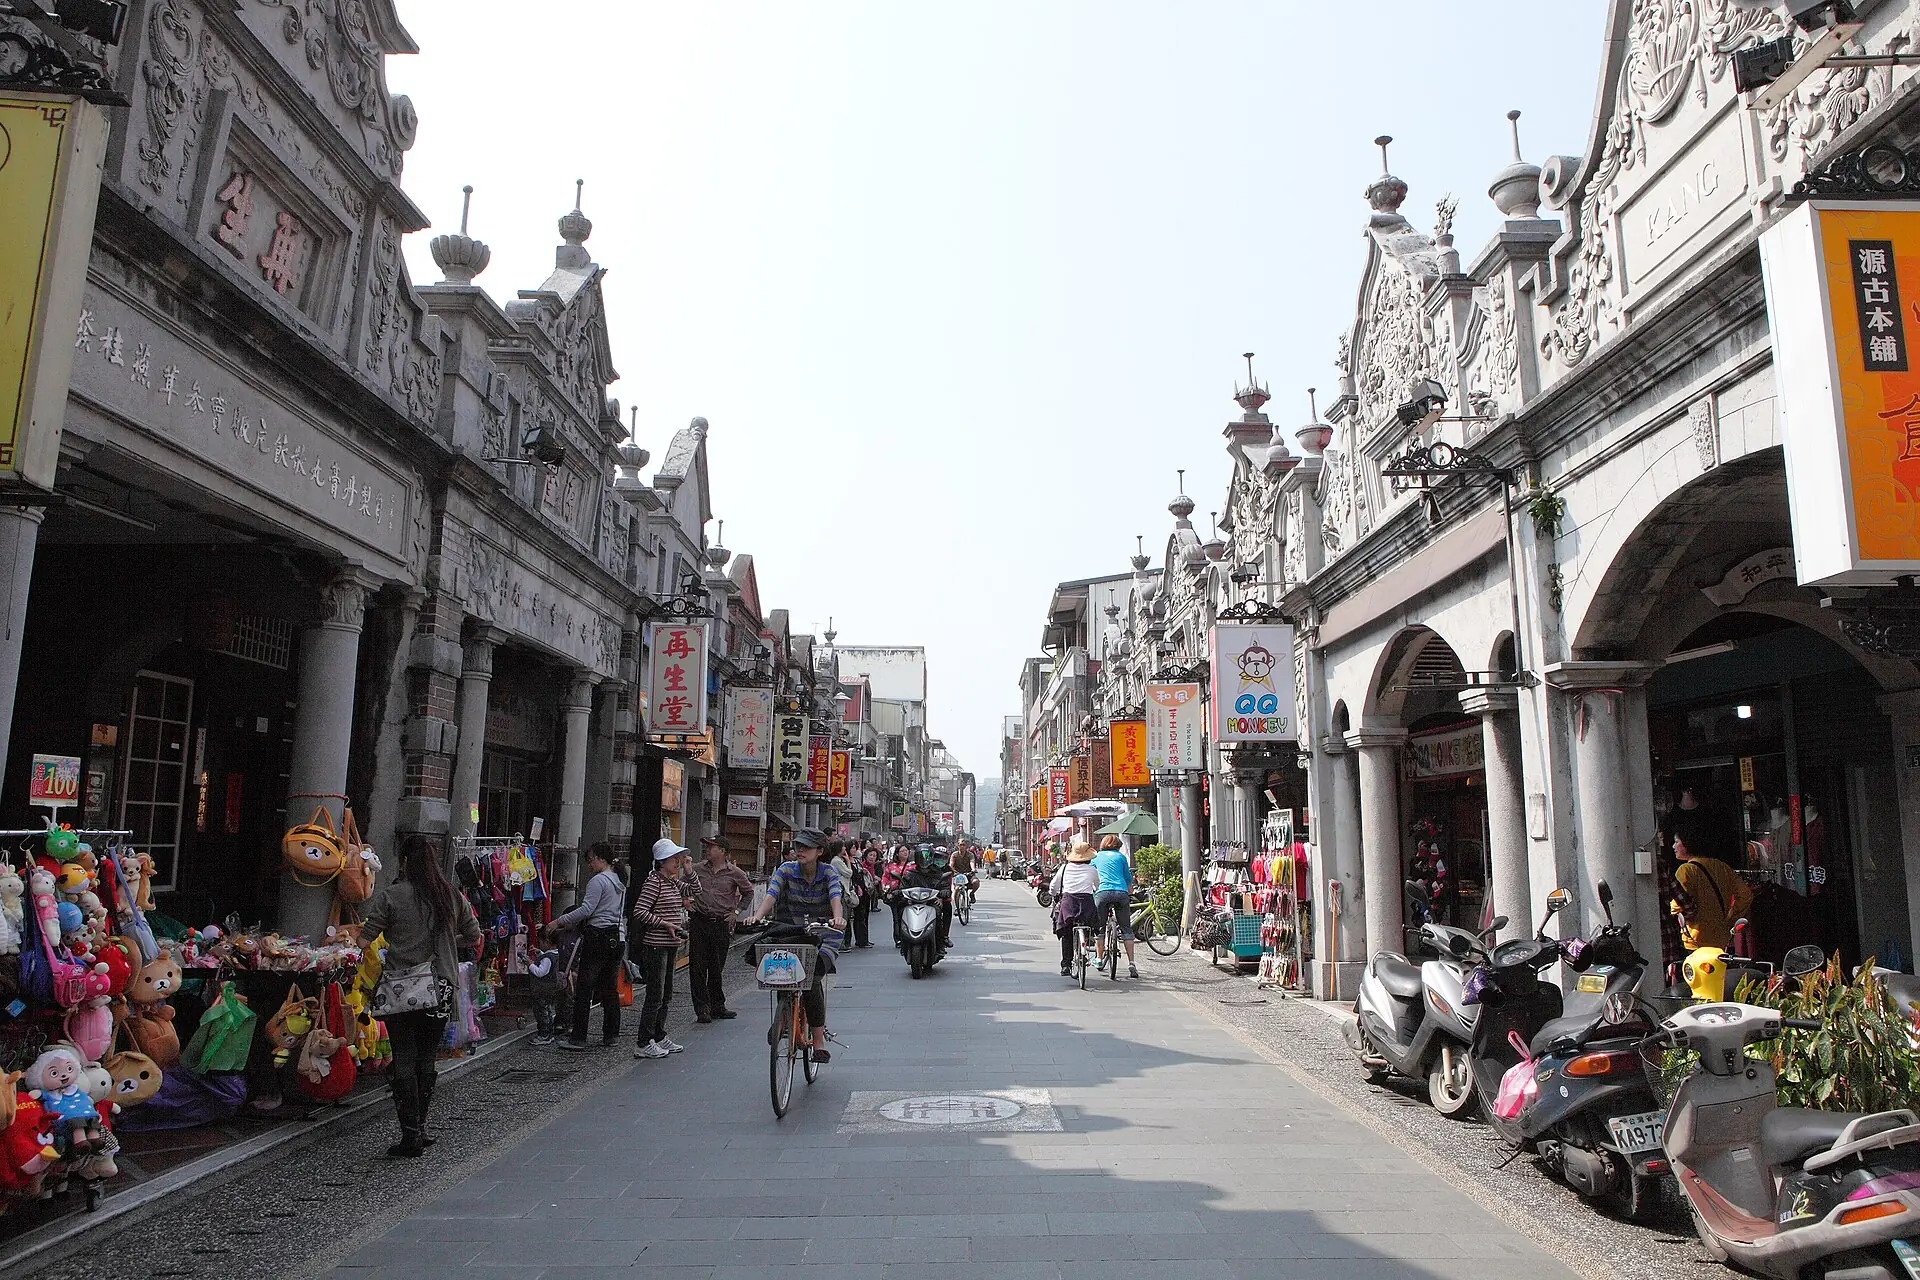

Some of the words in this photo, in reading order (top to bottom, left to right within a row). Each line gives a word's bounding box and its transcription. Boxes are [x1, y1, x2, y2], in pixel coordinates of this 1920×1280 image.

[1645, 160, 1720, 248] KANG
[1859, 247, 1899, 363] 源古本舖
[658, 630, 696, 727] 再生堂
[1156, 690, 1190, 703] 和風
[1235, 693, 1278, 715] QQ
[1227, 717, 1288, 735] MONKEY
[779, 716, 804, 782] 杏仁粉
[1121, 725, 1139, 763] 黃日香
[45, 766, 77, 796] 100
[730, 799, 758, 811] 杏仁粉
[773, 952, 788, 961] 263
